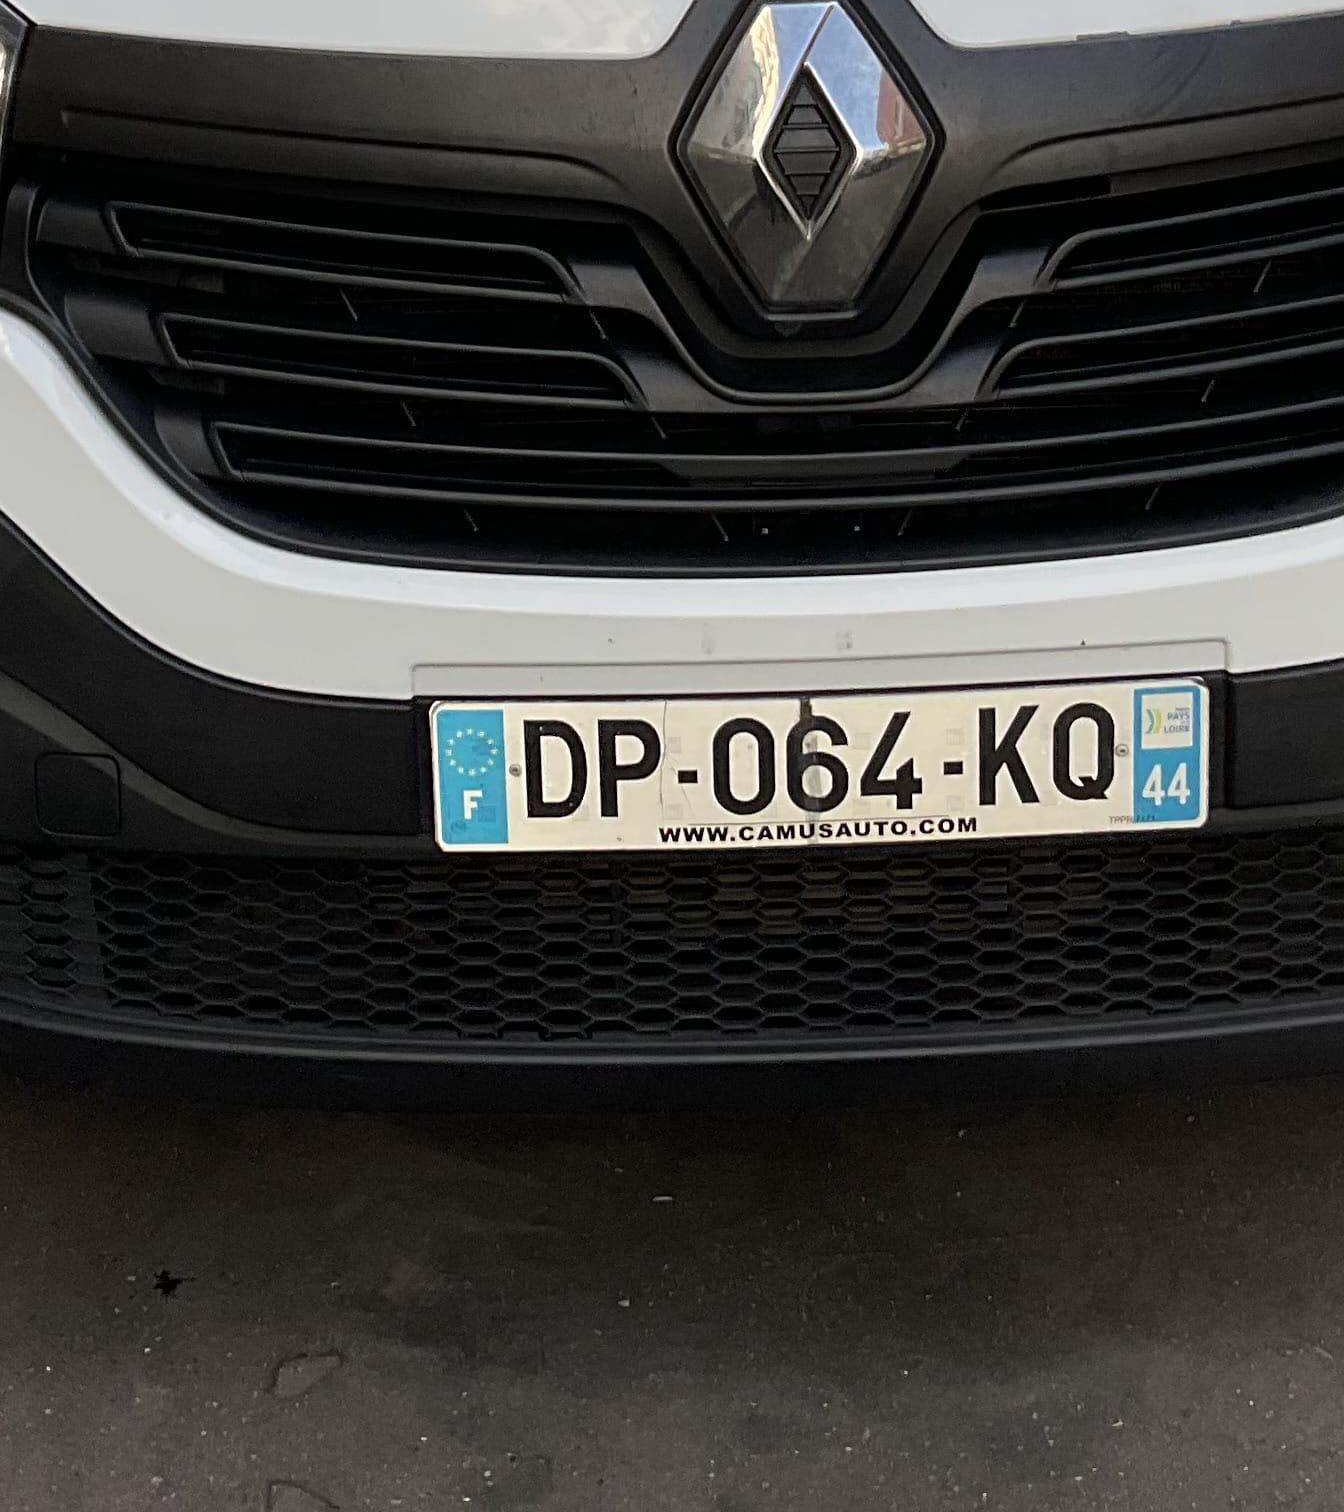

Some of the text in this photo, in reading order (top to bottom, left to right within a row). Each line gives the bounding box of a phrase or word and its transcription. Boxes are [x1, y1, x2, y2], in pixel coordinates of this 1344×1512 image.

[1163, 724, 1190, 734] LOIRE
[1167, 711, 1190, 721] PAYS
[523, 702, 1115, 818] DP-064-KQ
[1142, 762, 1190, 806] 44
[463, 790, 482, 820] F
[659, 817, 977, 843] WWW.CAMUSAUTO.COM
